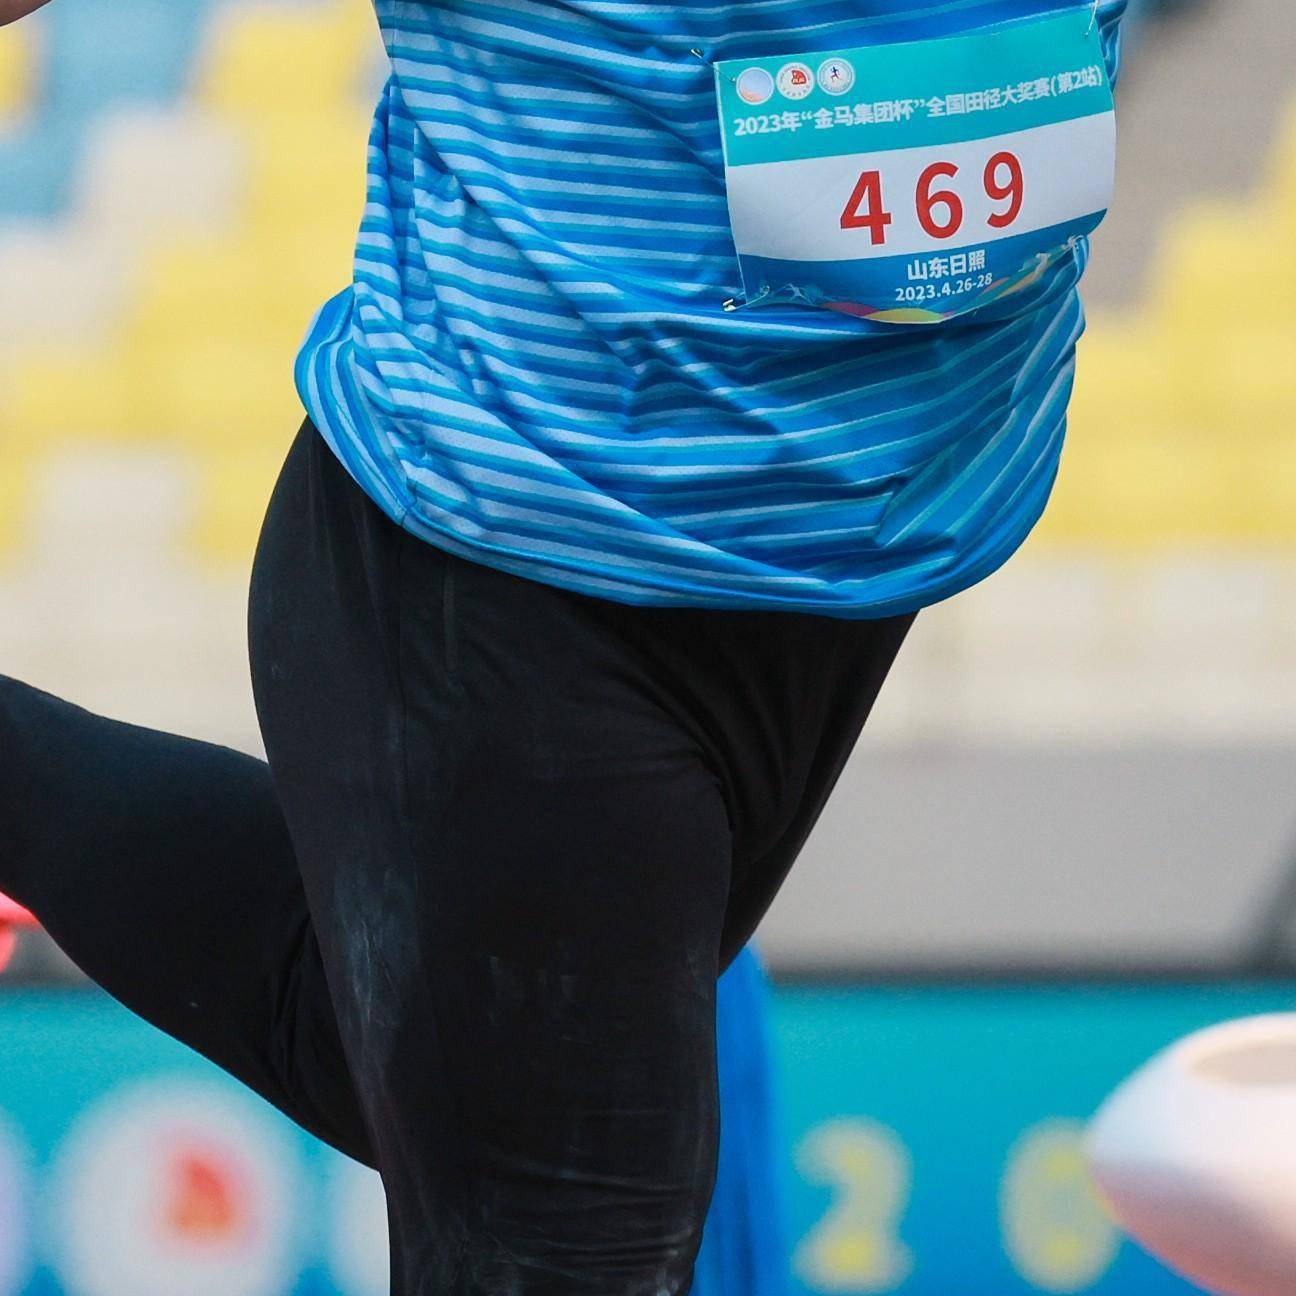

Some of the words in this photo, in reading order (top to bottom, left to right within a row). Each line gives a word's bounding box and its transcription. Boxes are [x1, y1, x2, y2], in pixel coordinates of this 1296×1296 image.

[839, 151, 1024, 246] 469
[907, 249, 986, 281] 山东日照
[895, 272, 993, 302] 2023.4.26-28
